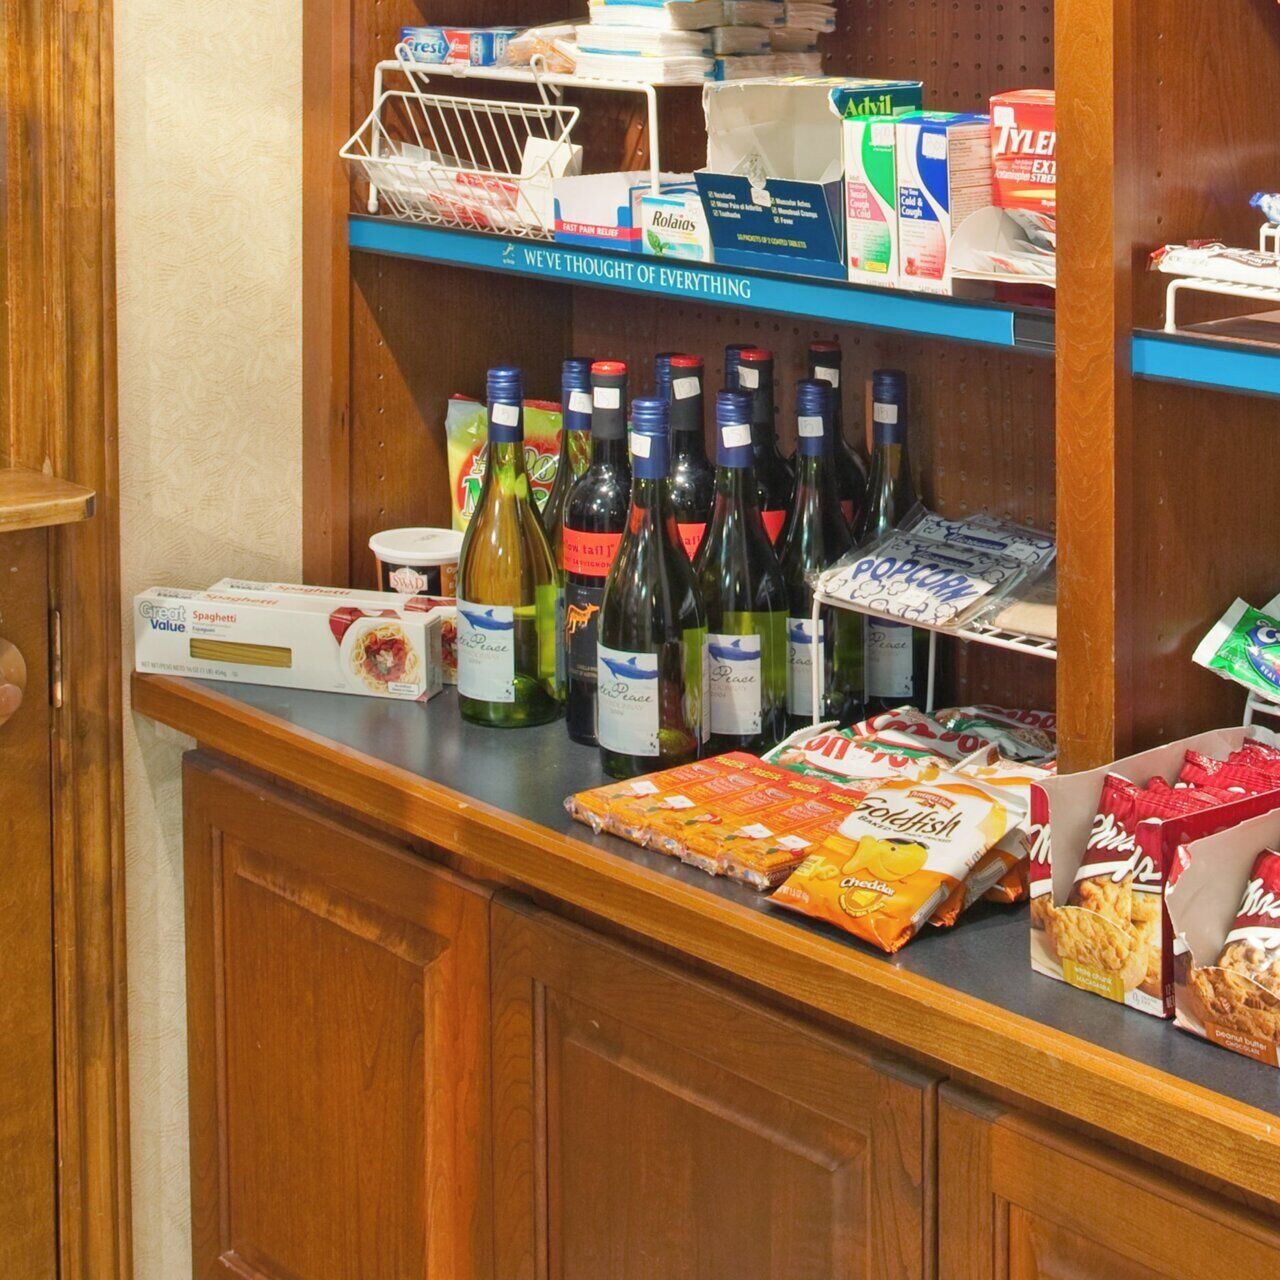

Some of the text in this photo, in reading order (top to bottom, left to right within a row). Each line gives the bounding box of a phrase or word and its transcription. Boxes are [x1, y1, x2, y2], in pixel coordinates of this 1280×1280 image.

[844, 94, 892, 118] Advil
[901, 195, 916, 207] Cold
[652, 210, 696, 233] Rolaids
[901, 206, 923, 218] Cough
[562, 222, 619, 237] FAST PAIN RELIEF
[523, 248, 751, 299] WE'VE THOUGHT OF EVERYTHING
[271, 583, 352, 596] Spaghetti
[392, 574, 426, 590] SWAD
[851, 556, 980, 604] POPCORN
[202, 591, 280, 606] Spaghetti
[138, 599, 187, 622] Great
[192, 609, 238, 625] Spaghetti
[150, 618, 187, 633] Value
[868, 631, 910, 650] Peace
[711, 664, 758, 685] Peace
[856, 796, 965, 837] Goldfish
[858, 815, 887, 832] BAKED
[840, 875, 896, 897] Cheddar
[1214, 1028, 1269, 1052] peanut butter
